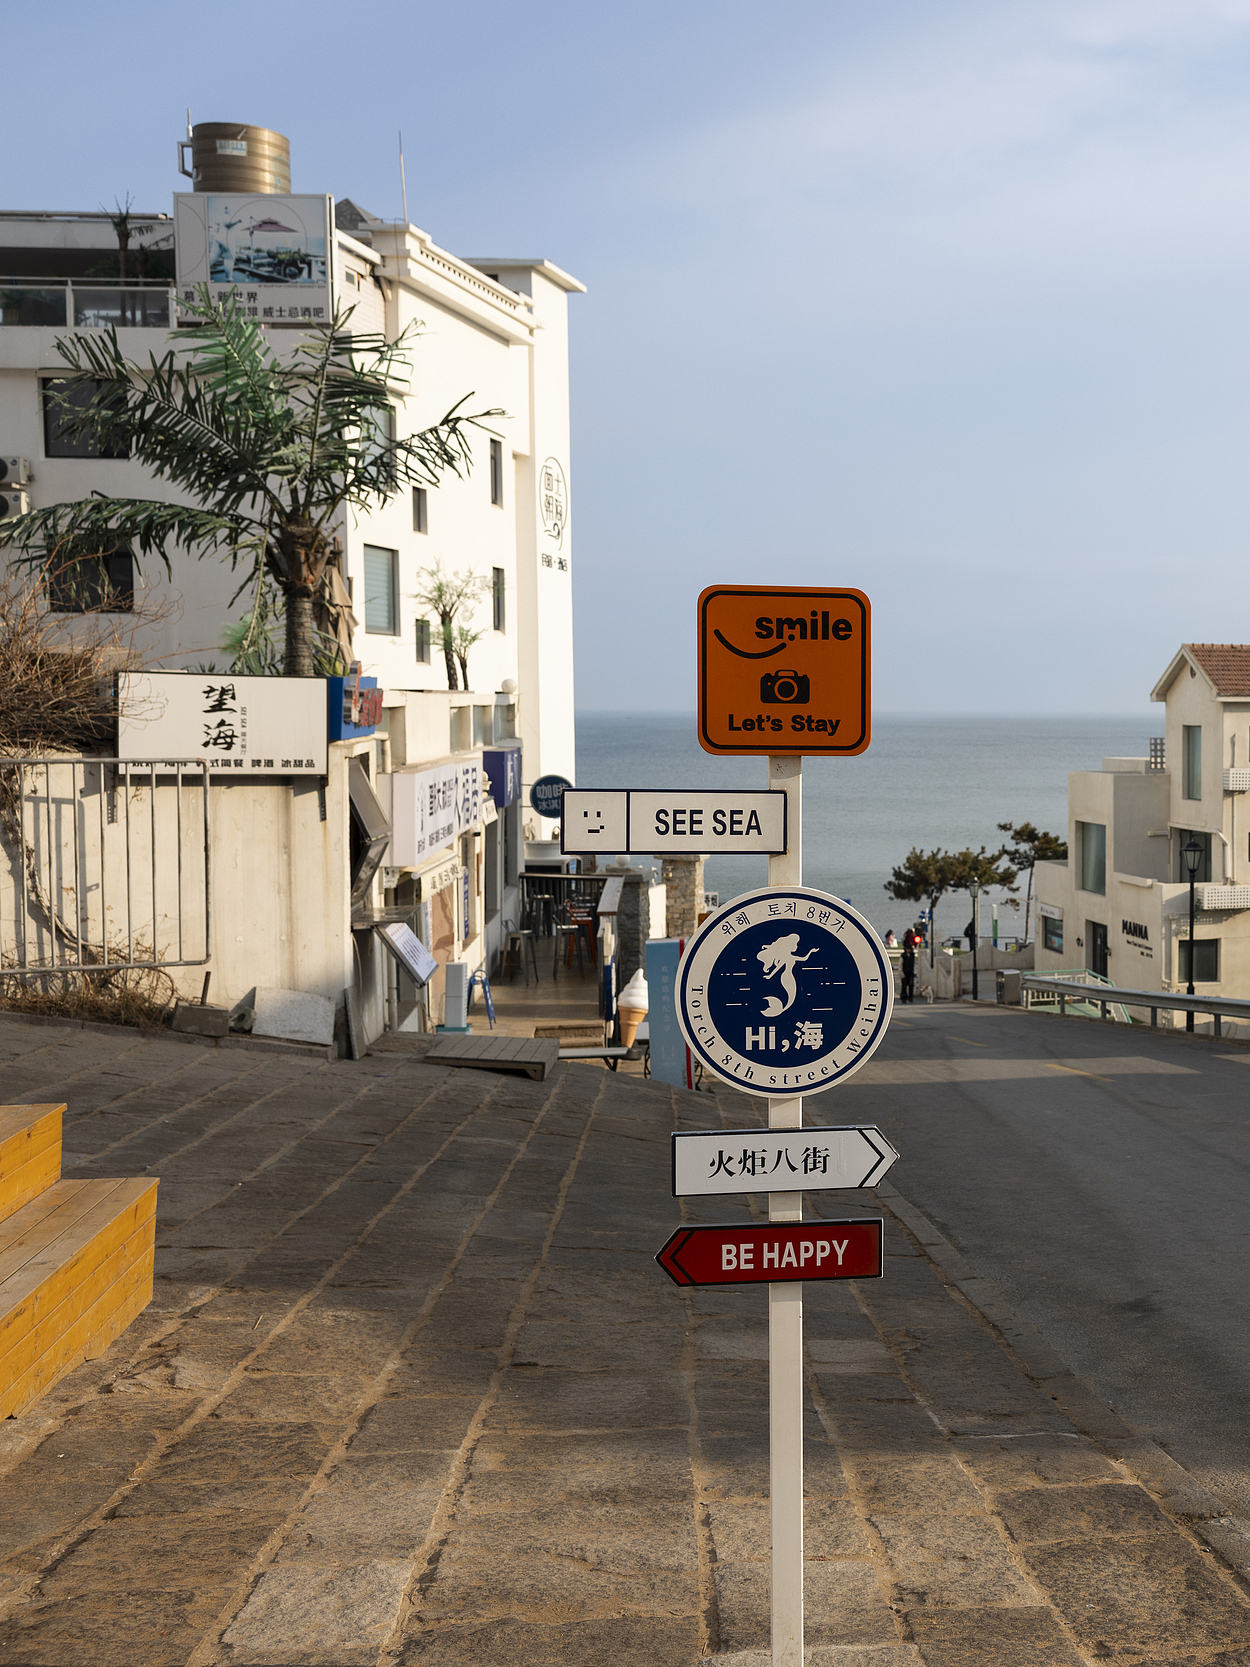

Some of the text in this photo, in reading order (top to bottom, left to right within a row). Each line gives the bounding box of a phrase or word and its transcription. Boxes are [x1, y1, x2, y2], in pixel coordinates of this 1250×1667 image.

[755, 610, 853, 641] smile
[202, 683, 239, 751] 望海
[728, 714, 841, 736] Let's Stay
[197, 759, 244, 768] 式简餐
[538, 799, 561, 811] 冰淇
[655, 809, 762, 835] SEE SEA
[721, 902, 846, 935] 위해 토치 8번가
[691, 985, 716, 1049] Torch
[721, 1054, 754, 1080] 8th
[769, 1059, 840, 1085] street
[847, 977, 879, 1054] Weihai
[708, 1147, 830, 1178] 火炬八街
[722, 1240, 849, 1270] BE HAPPY
